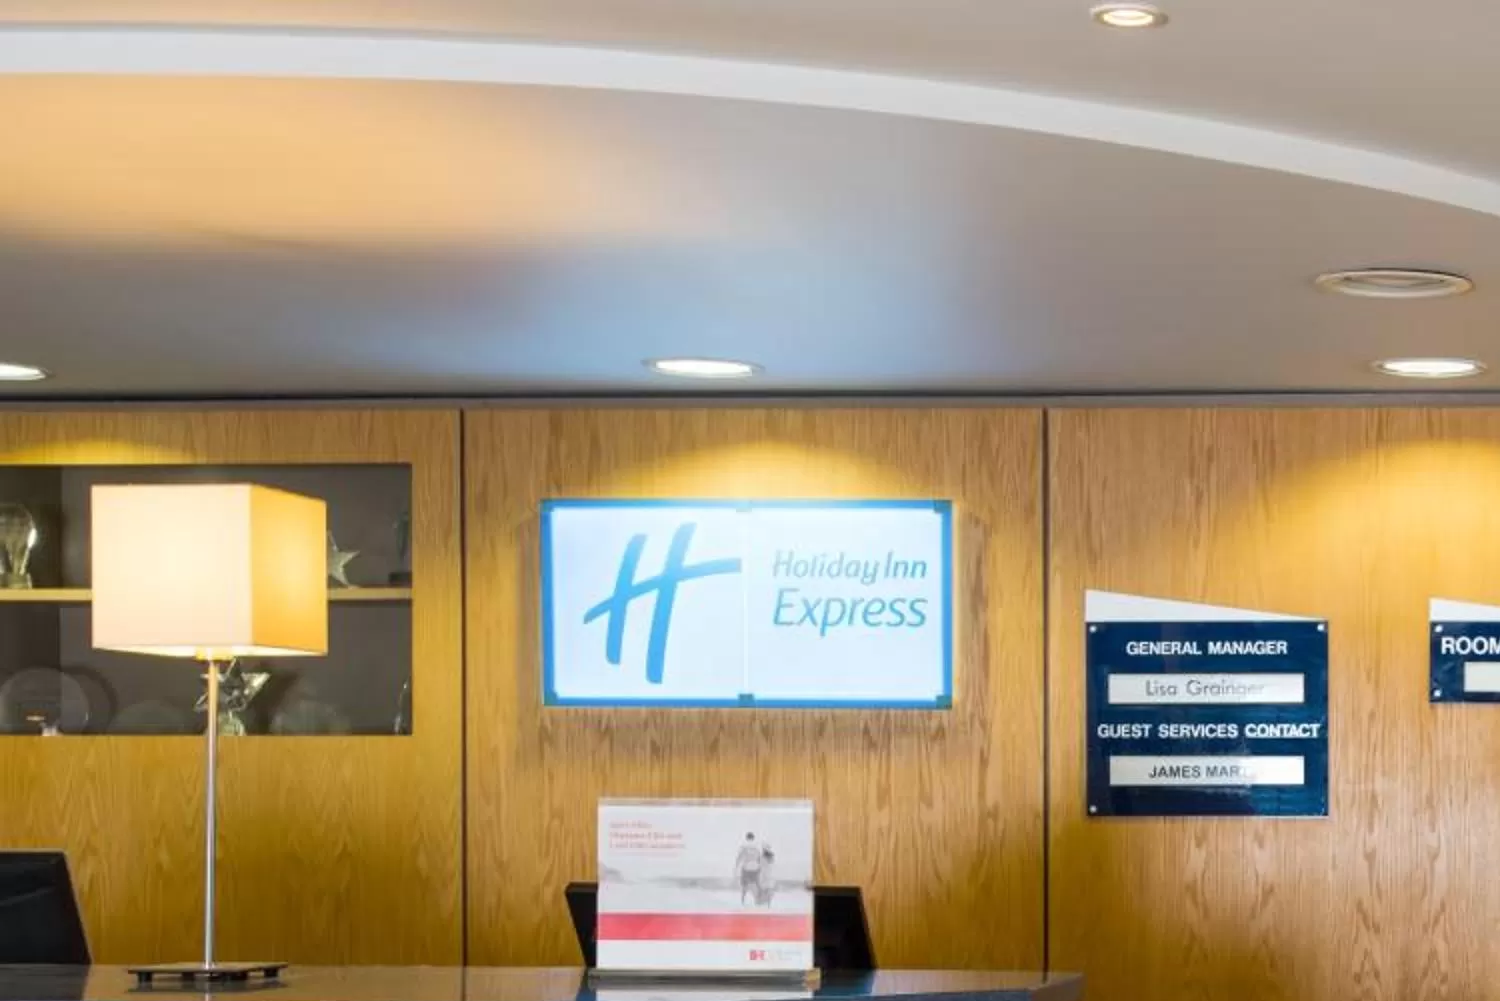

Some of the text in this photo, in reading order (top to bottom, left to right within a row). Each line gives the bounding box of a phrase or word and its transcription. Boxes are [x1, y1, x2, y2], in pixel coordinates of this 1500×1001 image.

[772, 549, 928, 587] Holiday Inn
[772, 587, 929, 638] Express
[1126, 640, 1289, 656] GENERAL MANAGER
[1145, 679, 1178, 697] Lisa
[1097, 723, 1321, 738] GUEST SERVICES CONTACT
[1148, 764, 1201, 779] JAMES
